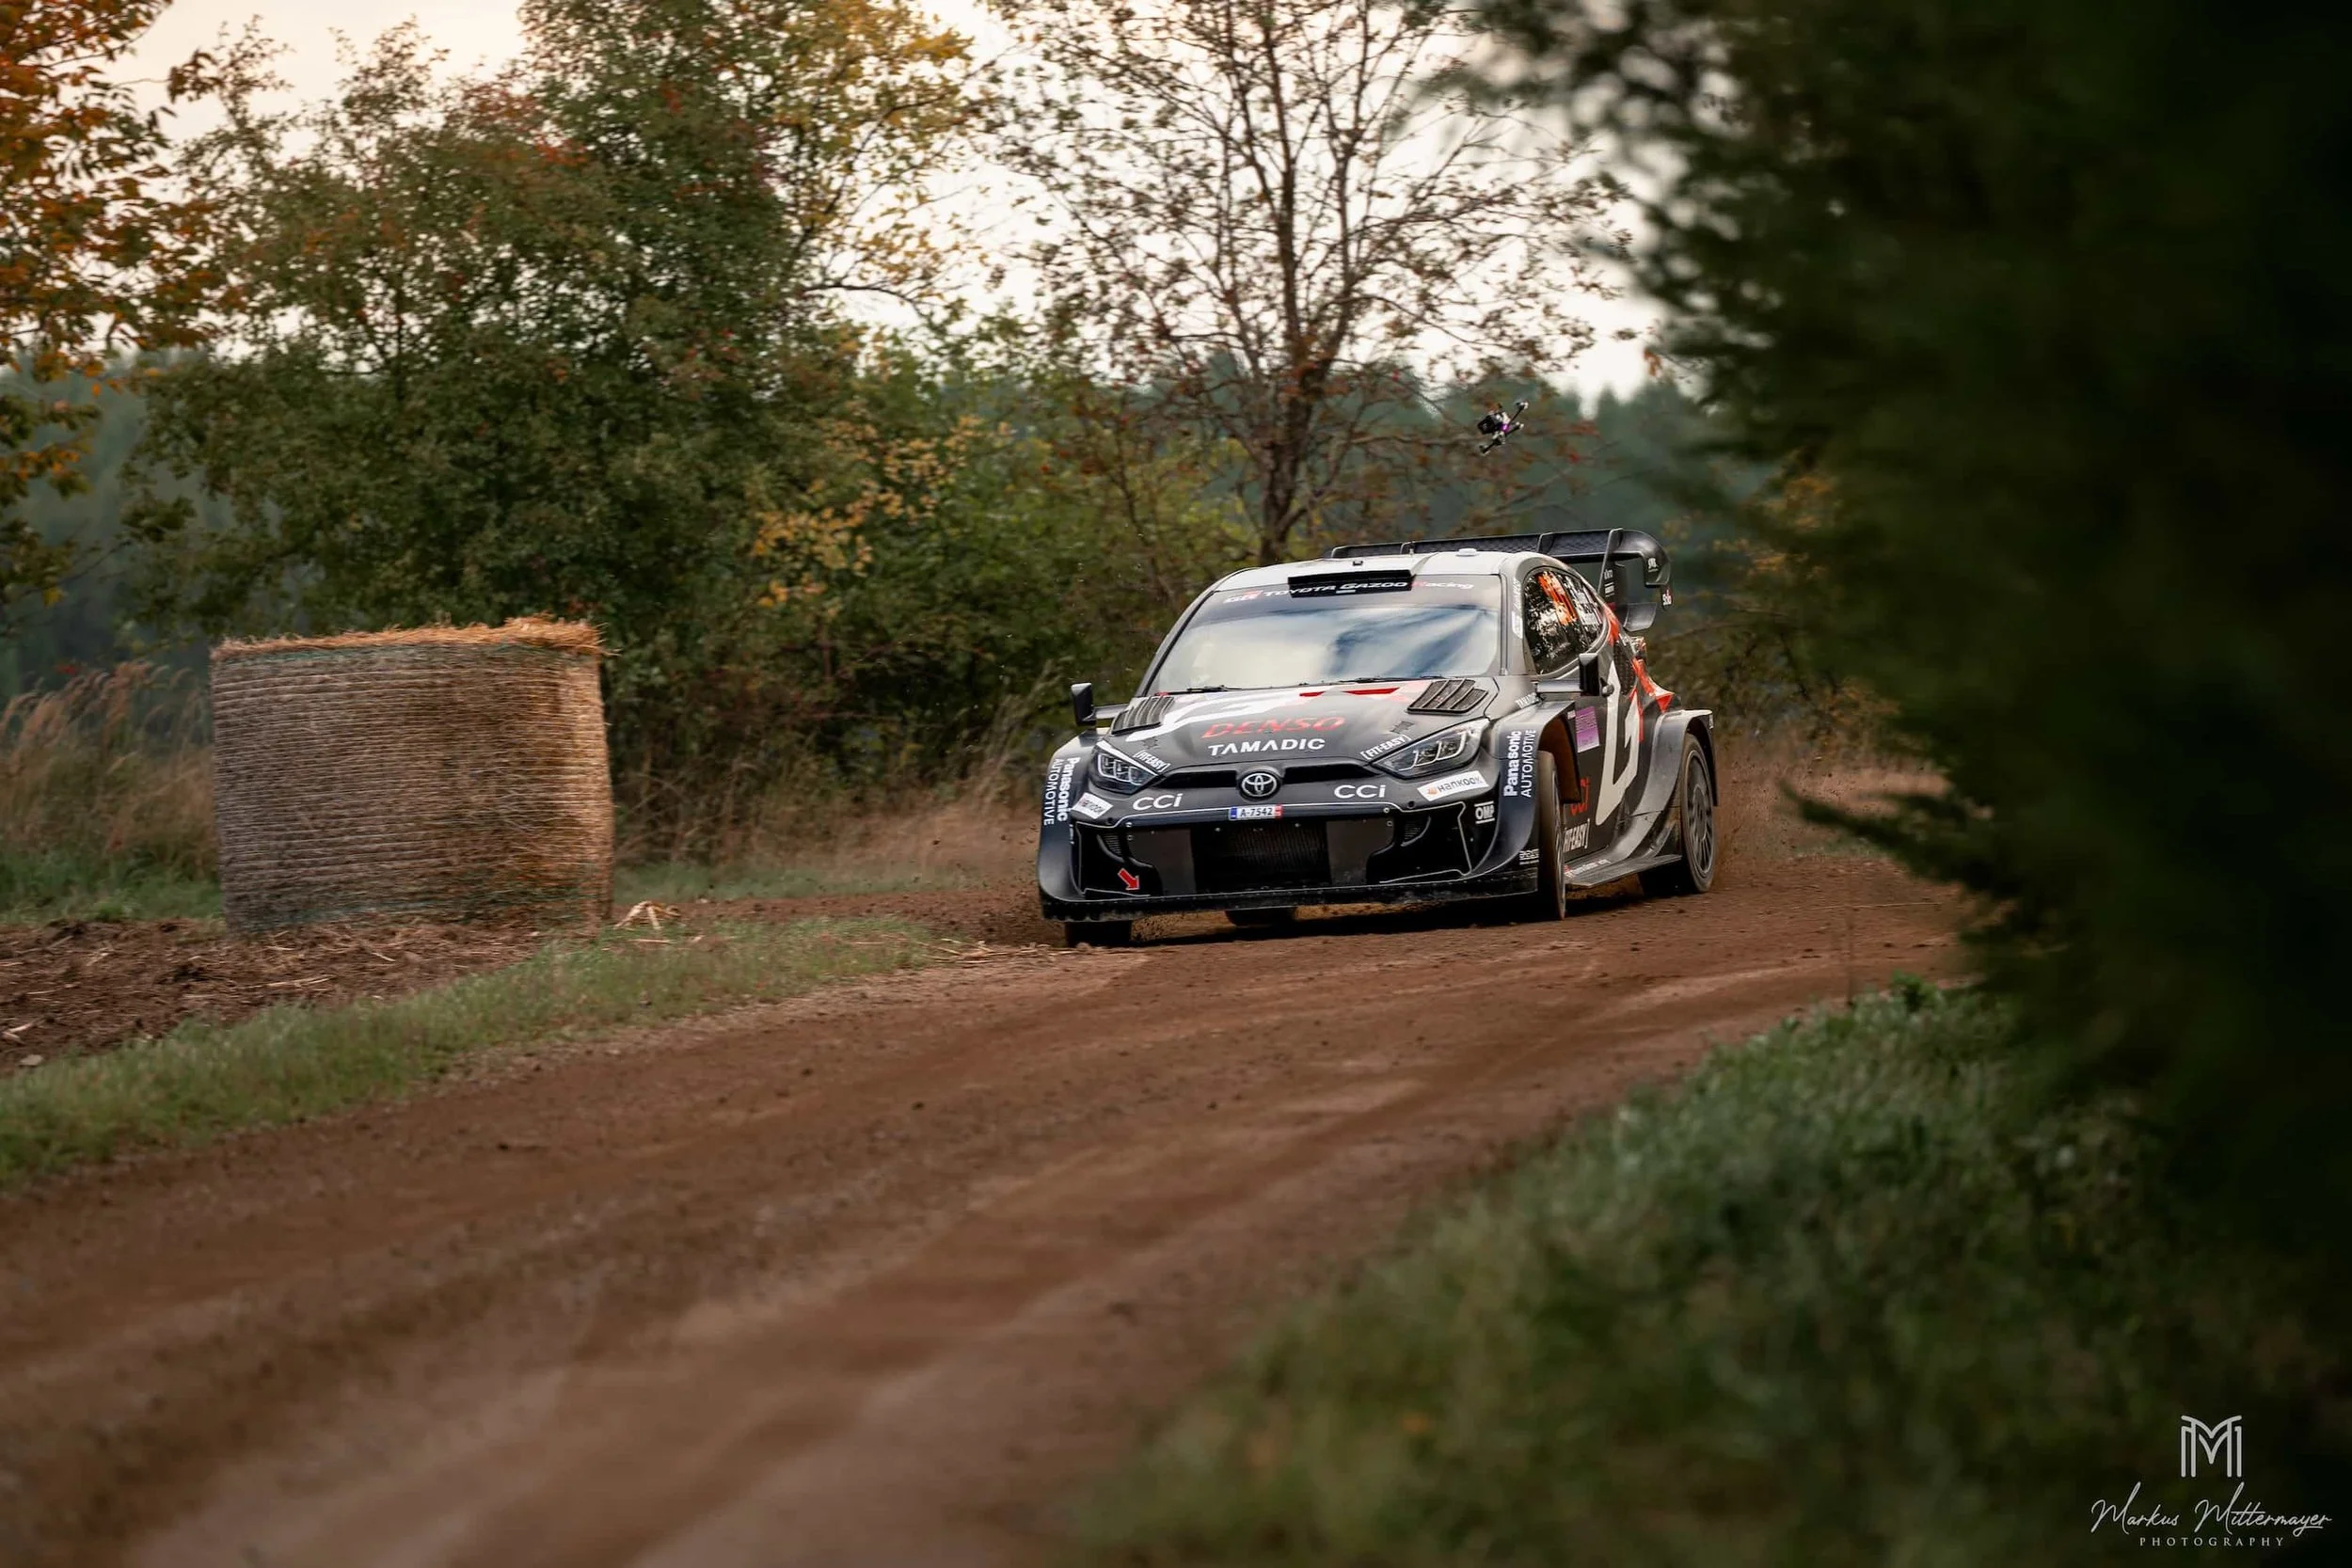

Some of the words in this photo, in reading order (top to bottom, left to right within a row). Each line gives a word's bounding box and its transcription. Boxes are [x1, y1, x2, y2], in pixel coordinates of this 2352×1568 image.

[1263, 585, 1336, 596] TOYOTA
[1339, 581, 1408, 590] GAZOO
[1200, 716, 1346, 738] DENSO
[1207, 738, 1327, 756] TAMADIC
[1503, 730, 1522, 797] Panasonic
[1520, 729, 1536, 798] AUTOMOTIVE
[1043, 758, 1062, 826] AUTOMOTIVE
[1057, 757, 1081, 822] Panasonic
[1240, 808, 1273, 817] A-7542
[1475, 805, 1495, 820] OMP
